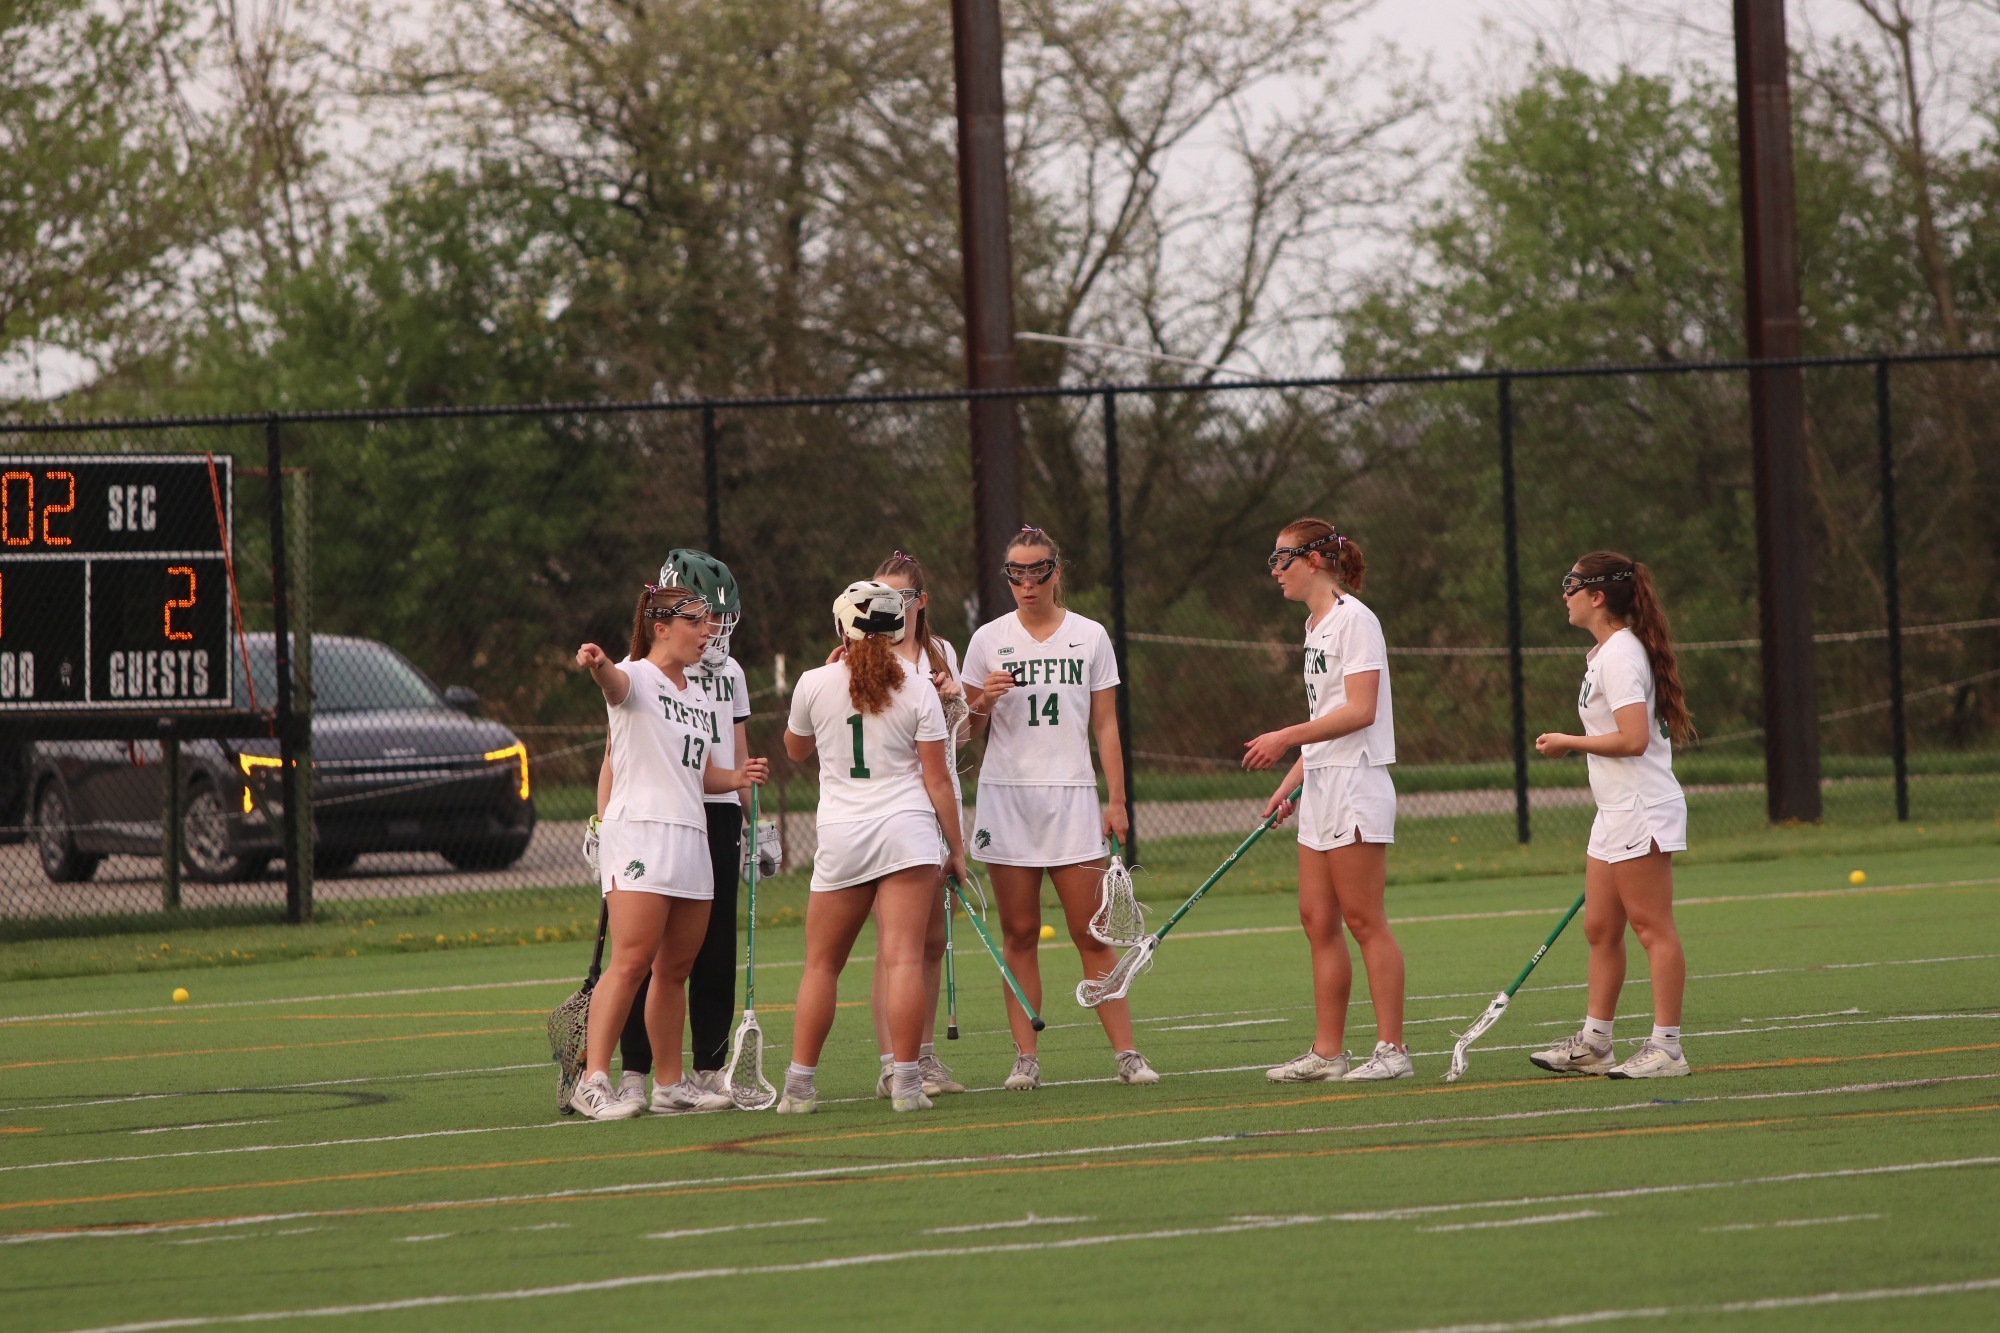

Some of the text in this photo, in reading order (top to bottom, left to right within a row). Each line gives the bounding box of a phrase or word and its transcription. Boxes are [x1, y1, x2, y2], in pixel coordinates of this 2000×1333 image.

[2, 471, 75, 546] 02
[108, 484, 156, 532] SEC
[164, 566, 196, 640] 2
[110, 649, 208, 697] GUESTS
[1002, 659, 1084, 685] TIFFIN
[1027, 692, 1059, 726] 14
[681, 734, 705, 770] 13
[847, 713, 870, 778] 1
[1531, 944, 1547, 965] GAIT
